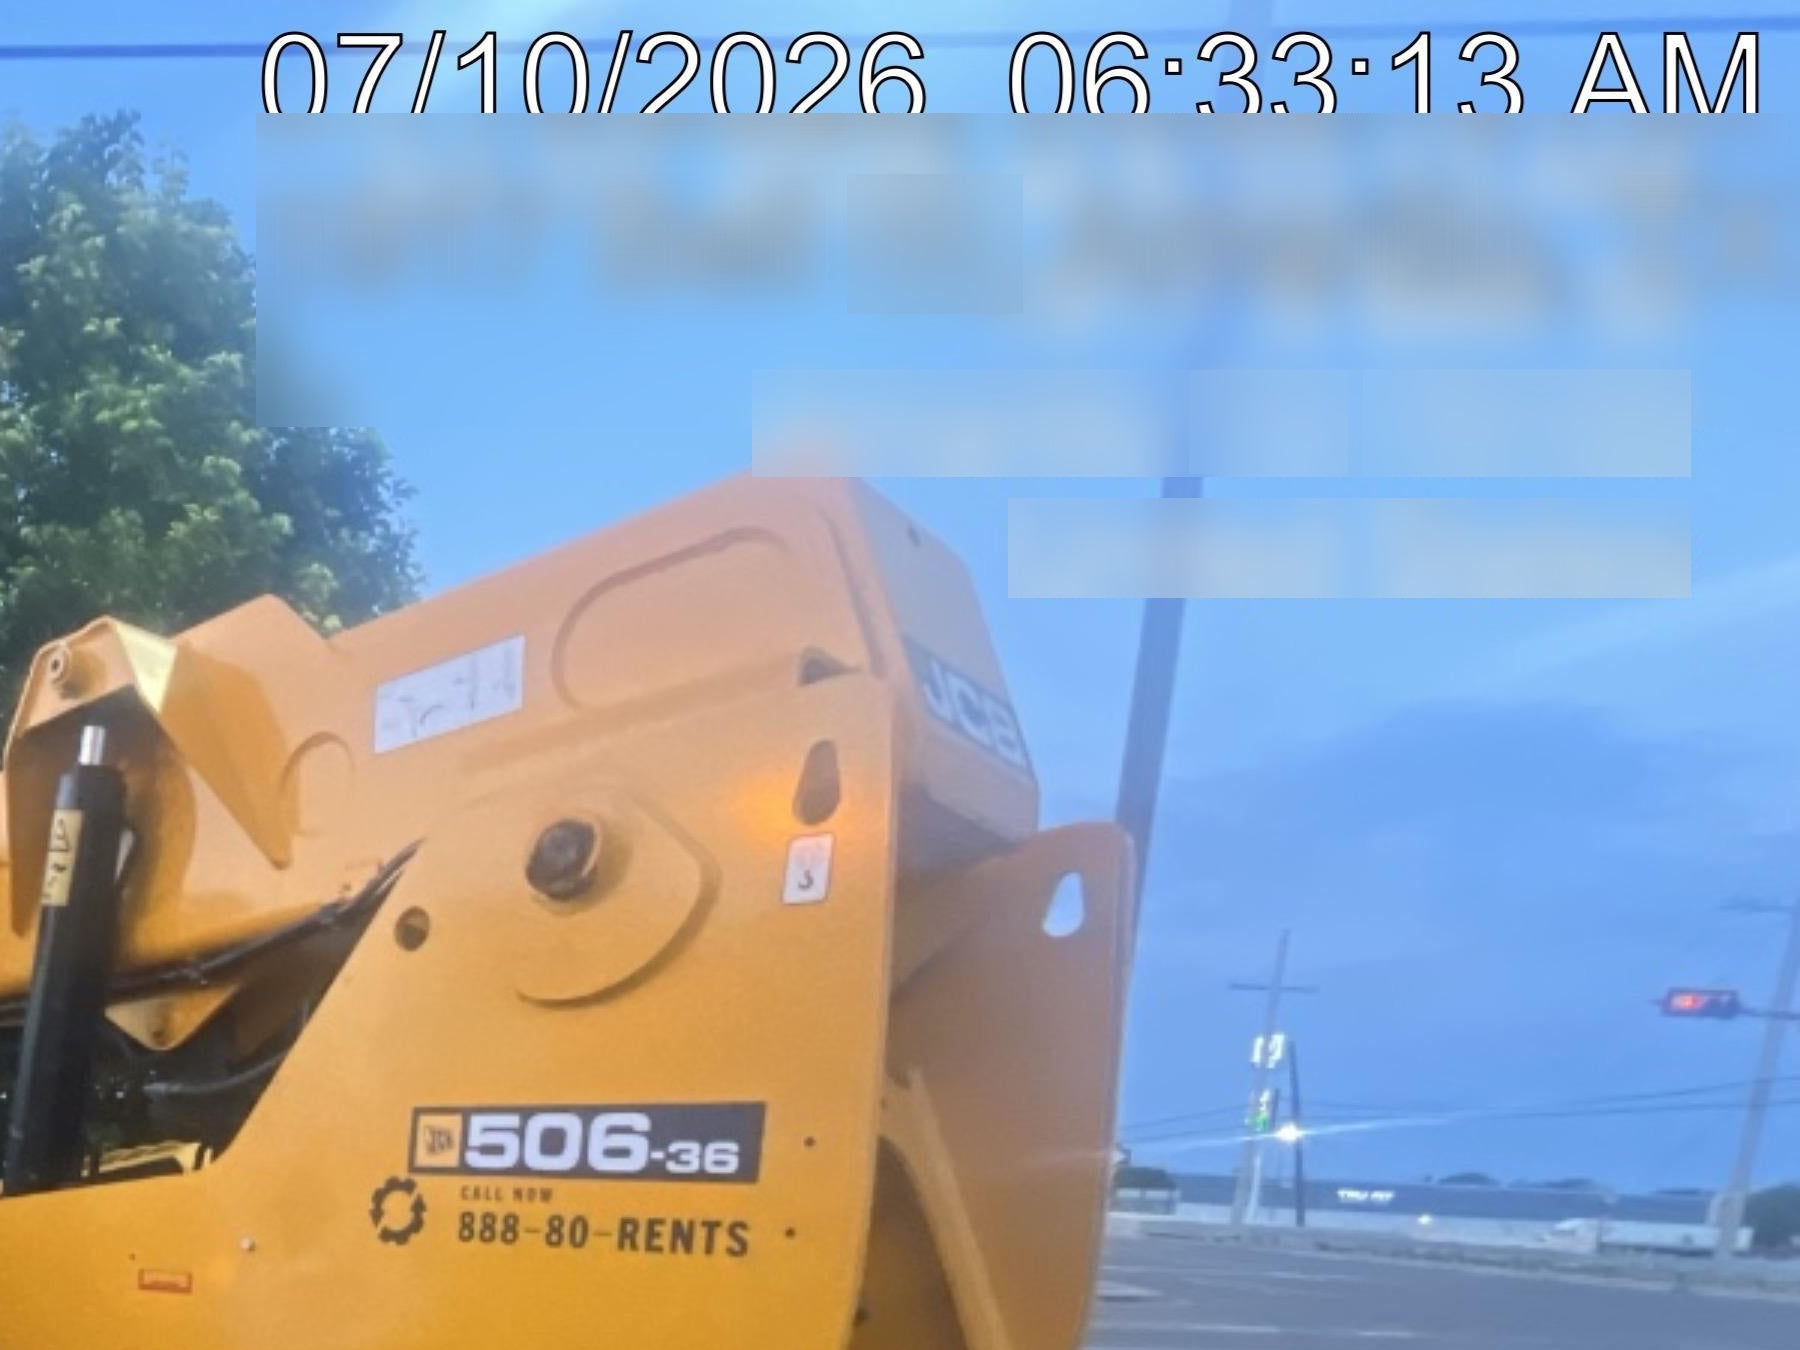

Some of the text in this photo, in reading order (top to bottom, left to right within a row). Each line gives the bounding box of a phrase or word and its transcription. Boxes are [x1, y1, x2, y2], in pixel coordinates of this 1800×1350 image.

[465, 1112, 739, 1174] 506-36
[460, 1185, 553, 1204] CALL NOW
[458, 1210, 749, 1258] 888-80-RENTS
